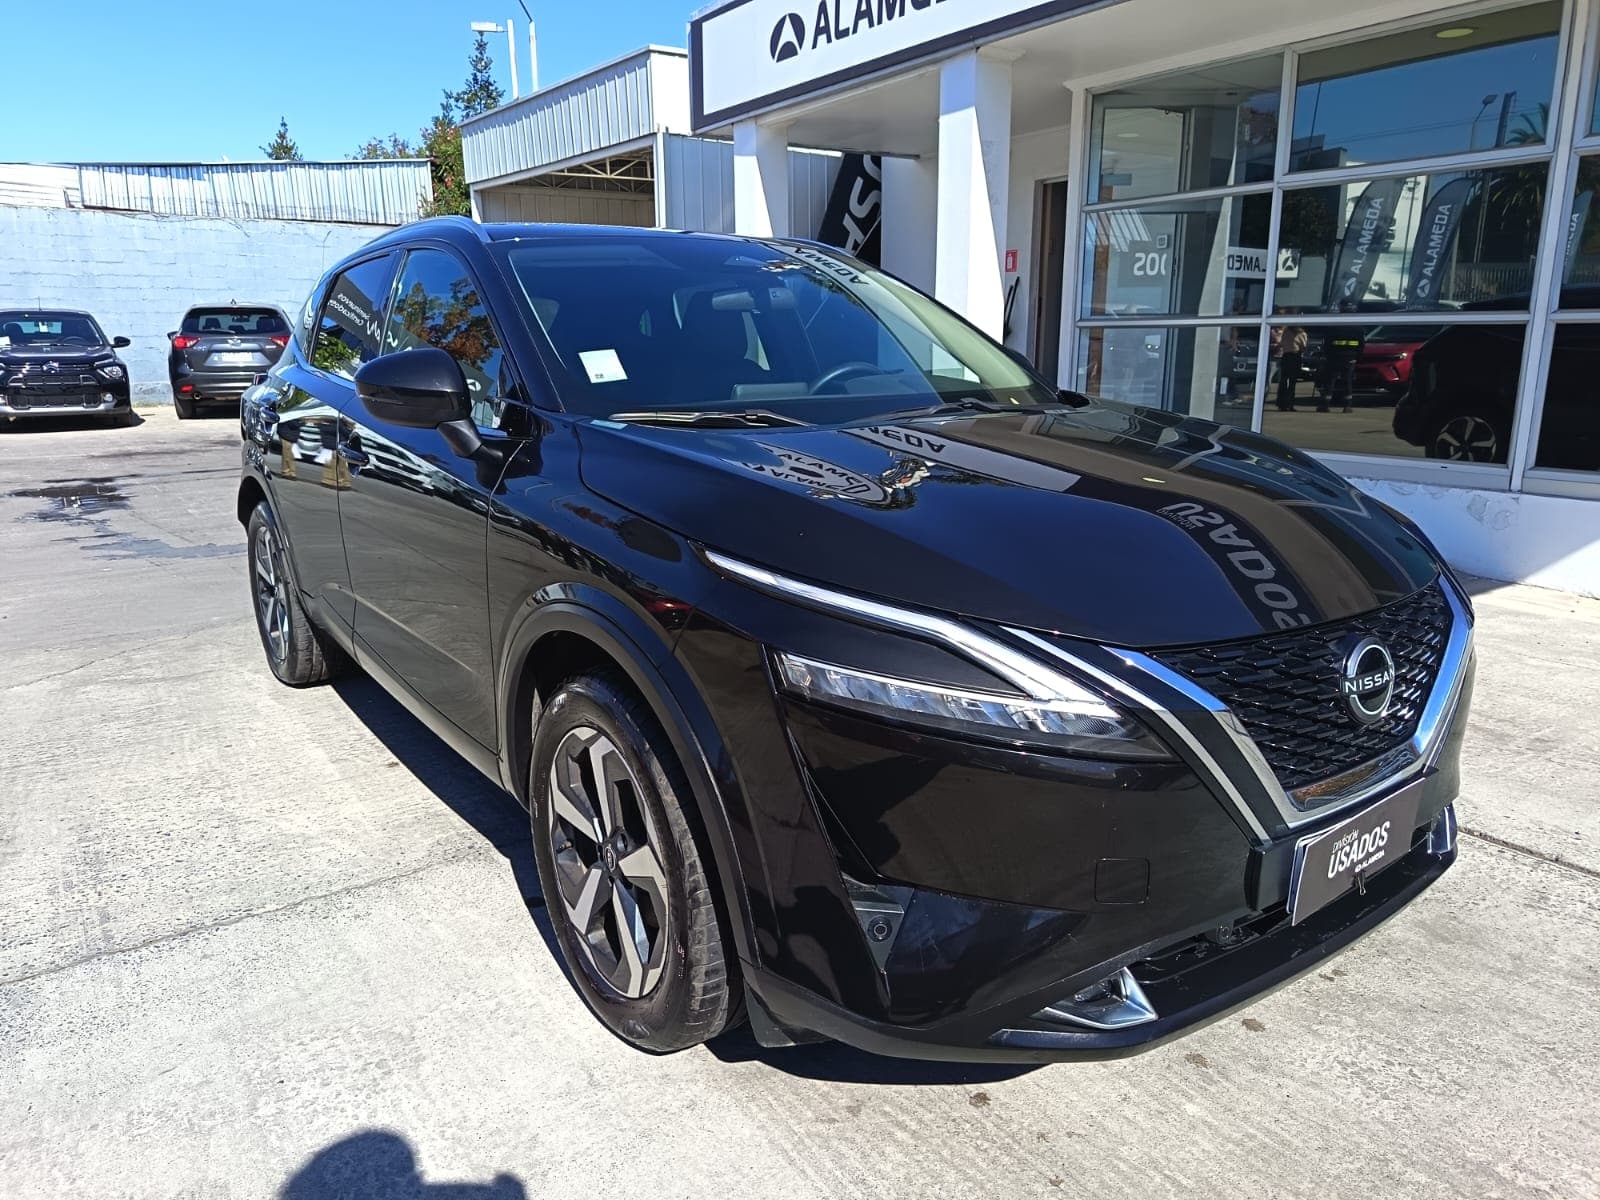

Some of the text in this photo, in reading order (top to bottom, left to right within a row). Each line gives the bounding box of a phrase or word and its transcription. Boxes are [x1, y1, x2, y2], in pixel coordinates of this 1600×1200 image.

[1351, 197, 1384, 274] ALAMEDA
[1422, 204, 1452, 277] ALAMEDA
[1345, 668, 1394, 693] NISSAN
[1328, 821, 1390, 878] USADOS
